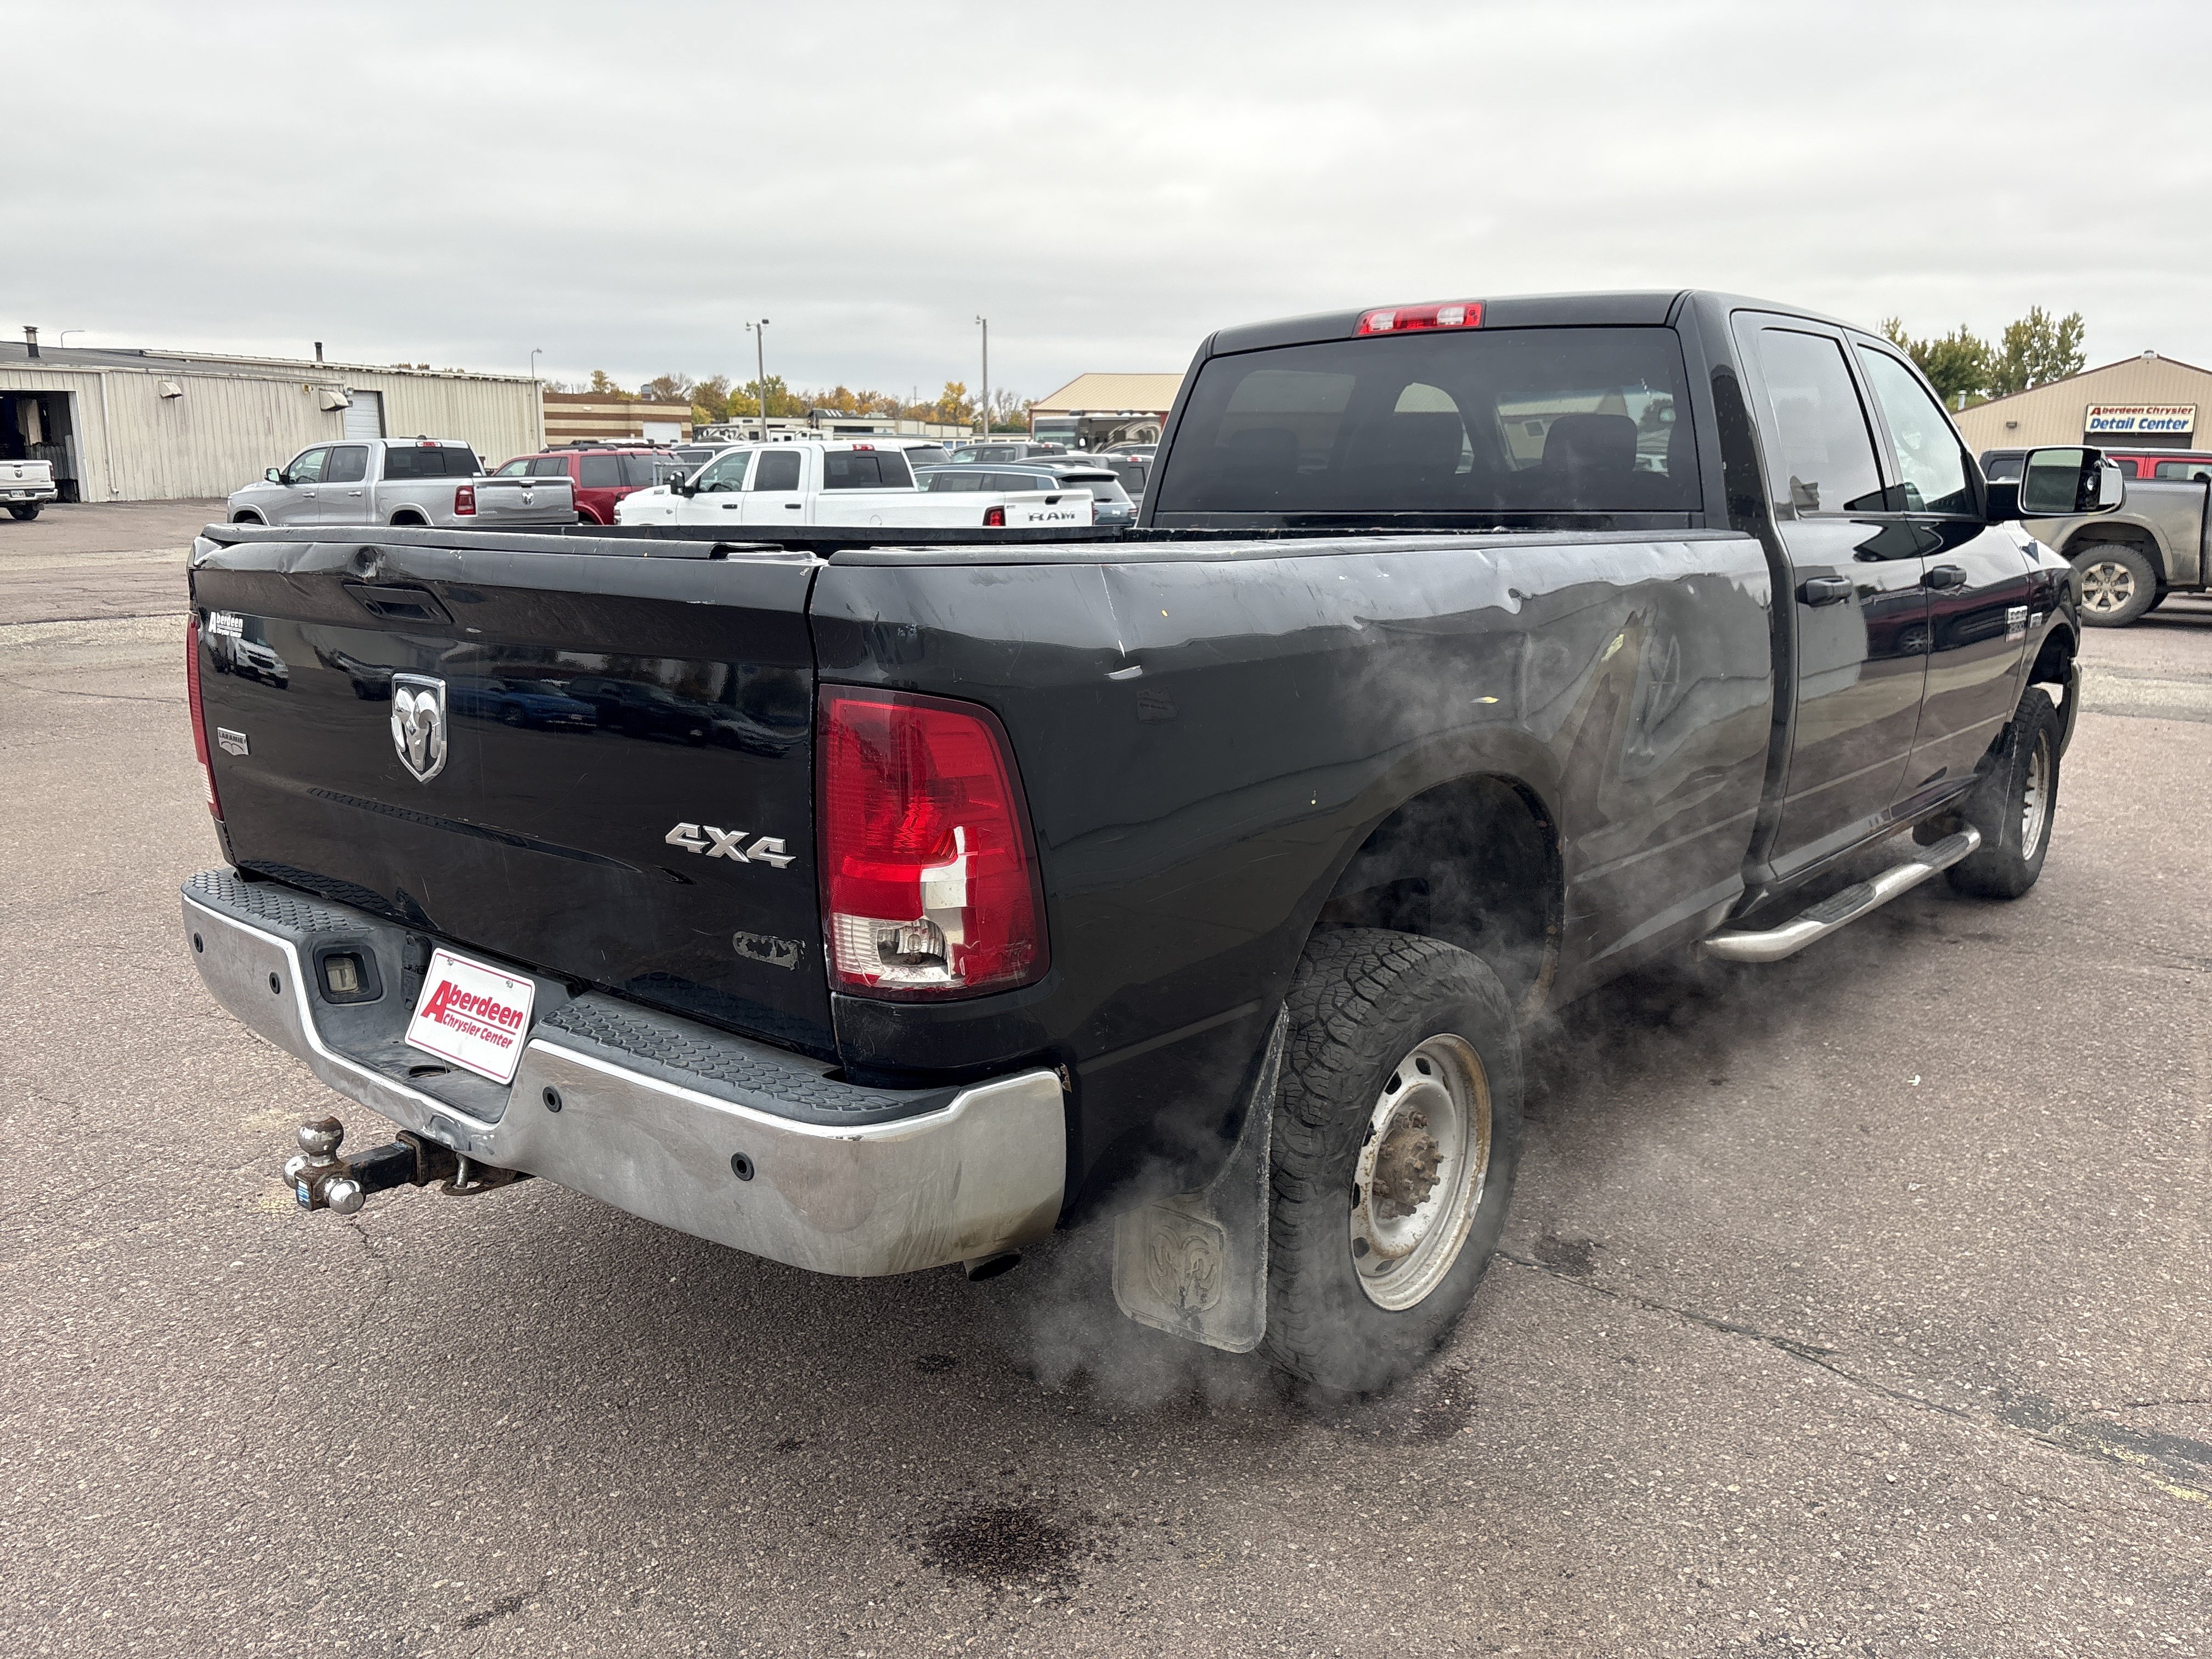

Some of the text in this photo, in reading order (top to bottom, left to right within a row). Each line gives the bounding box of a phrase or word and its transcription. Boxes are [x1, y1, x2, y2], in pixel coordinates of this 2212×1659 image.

[2090, 407, 2145, 416] Aberdeen
[2090, 417, 2190, 430] Detail Center
[1028, 510, 1075, 522] RAM
[208, 611, 243, 633] Aberdeen
[218, 731, 244, 744] LARAMIE
[420, 980, 523, 1029] Aberdeen
[442, 1013, 514, 1048] Chrysler Center
